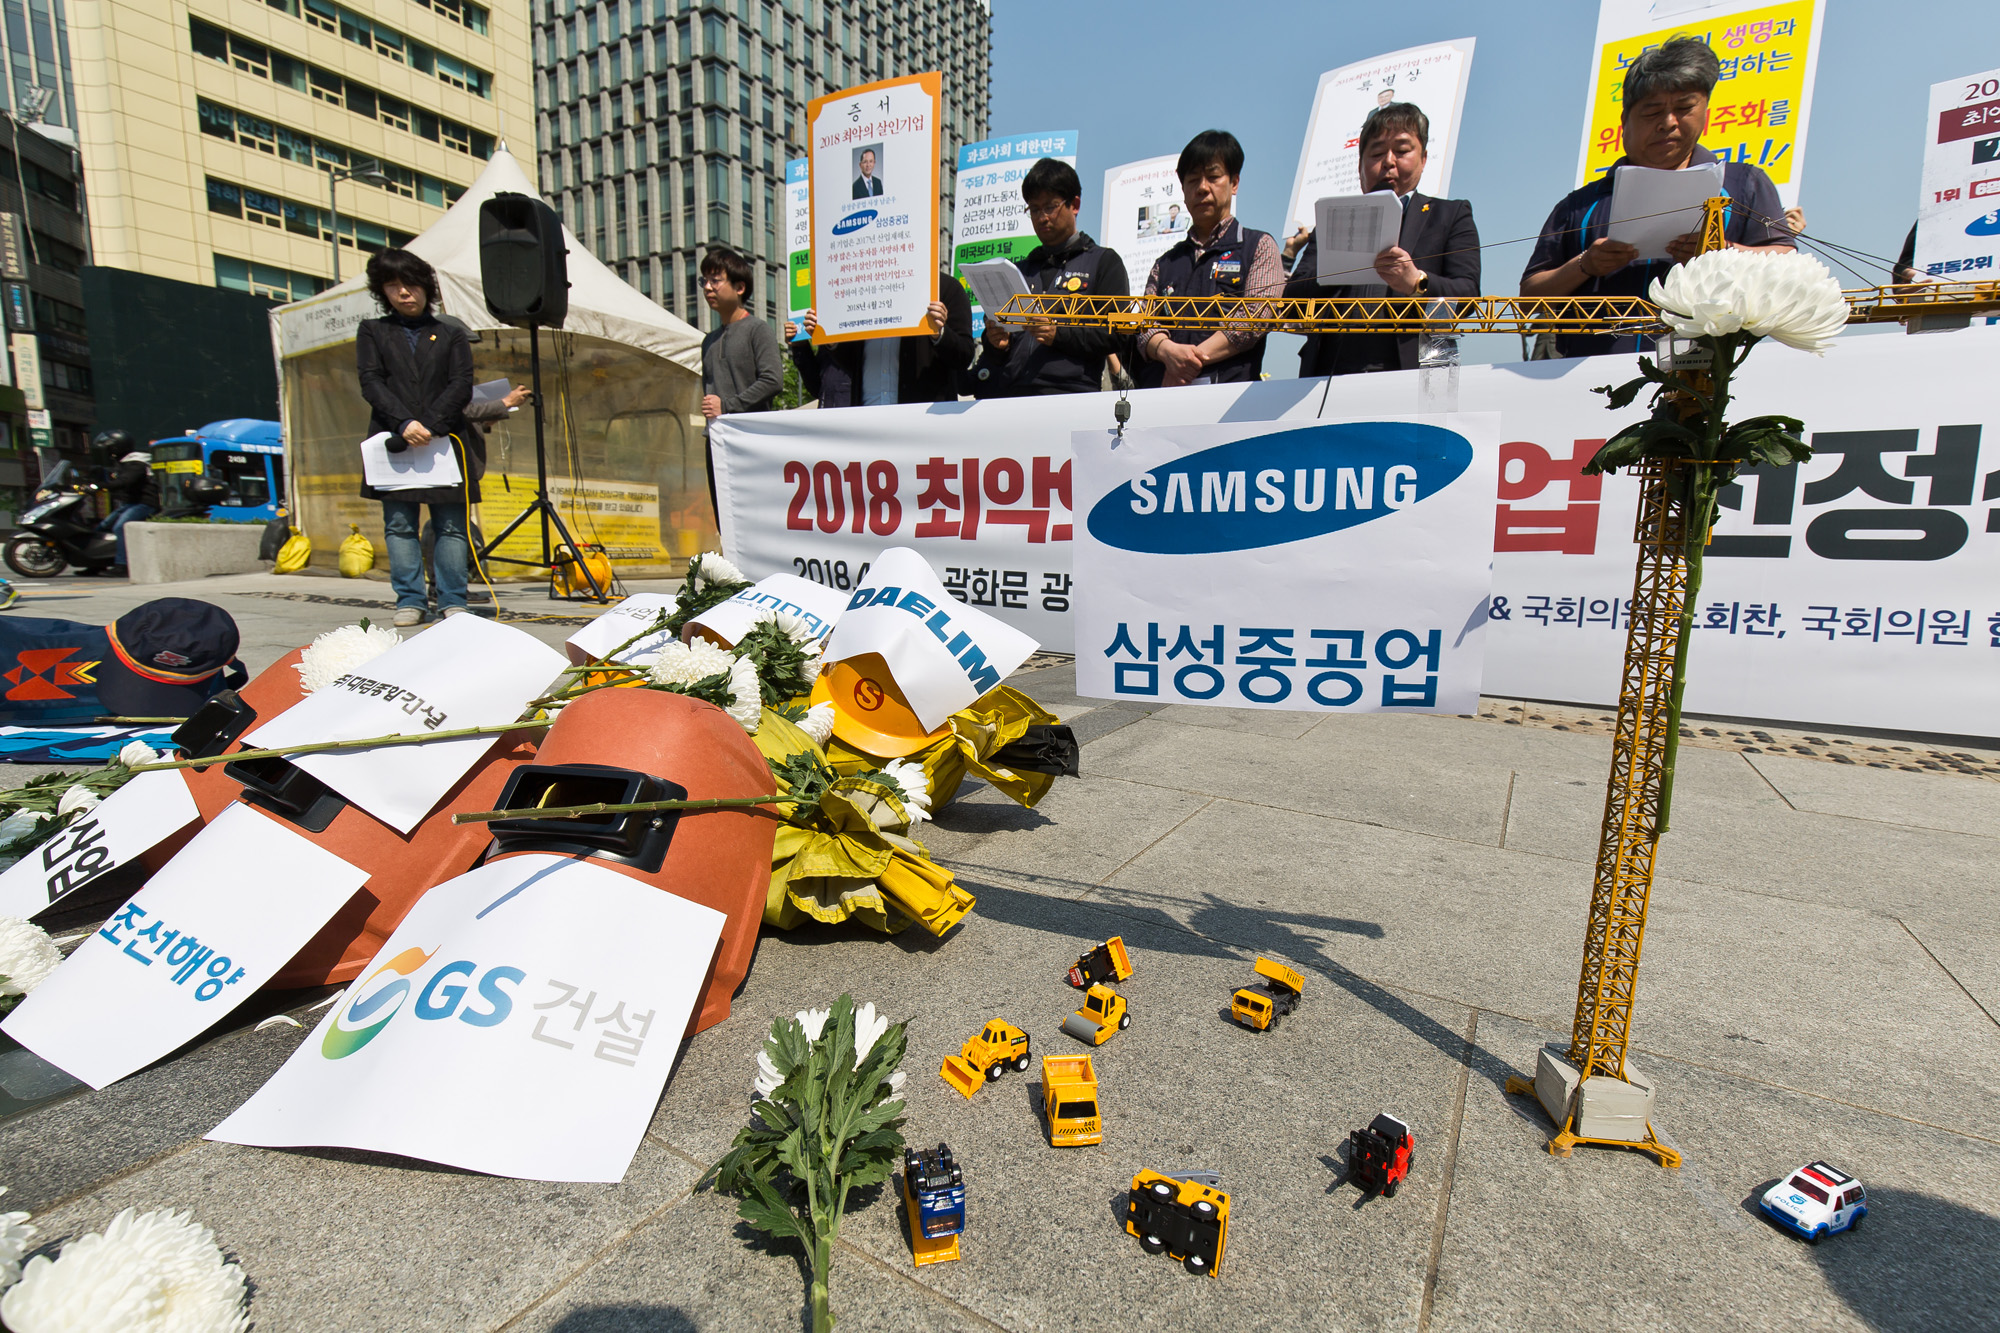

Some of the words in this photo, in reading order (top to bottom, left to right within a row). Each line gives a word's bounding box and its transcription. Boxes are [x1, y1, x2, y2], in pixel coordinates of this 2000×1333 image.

[1721, 18, 1797, 49] 생명과
[1382, 73, 1396, 86] 별
[1405, 68, 1422, 82] 상
[1718, 50, 1793, 81] 협하는
[1965, 78, 2000, 101] 20
[847, 102, 862, 122] 증
[877, 95, 890, 114] 서
[1702, 99, 1791, 137] 주화를
[819, 133, 841, 149] 2018
[842, 123, 874, 143] 최악의
[876, 115, 925, 136] 살인기업
[967, 142, 1012, 164] 과로사회
[1016, 137, 1067, 155] 대한민국
[792, 187, 809, 202] "일
[964, 194, 982, 208] 20대
[984, 189, 1020, 204] IT노동자,
[1934, 186, 1961, 204] 1위
[836, 215, 873, 230] SAMSUNG
[876, 214, 909, 228] 삼성중공업
[963, 207, 995, 223] 심근경색
[996, 203, 1027, 217] 사망(과
[961, 222, 994, 238] (2016년
[996, 219, 1019, 232] 11월)
[960, 243, 995, 260] 미국보다
[997, 240, 1013, 255] 1달
[840, 262, 858, 273] 최악의
[855, 272, 873, 283] 최악의
[874, 269, 915, 281] 살인기업으로
[1926, 255, 1994, 276] 공동2위
[846, 301, 866, 312] 2018년
[878, 298, 893, 309] 25일
[783, 459, 903, 537] 2018
[1129, 464, 1418, 515] SAMSUNG
[1494, 438, 1607, 556] 업
[943, 567, 1029, 610] 광화문
[1041, 572, 1073, 613] 광
[736, 589, 831, 640] UNDAI
[1488, 595, 1512, 621] &
[1801, 605, 1971, 647] 국회의원
[846, 586, 1001, 696] DAELIM
[1104, 622, 1442, 708] 삼성중공업
[98, 902, 246, 1001] 조선해양
[414, 960, 528, 1028] GS
[531, 979, 657, 1068] 건설
[1774, 1195, 1806, 1215] POLICE
